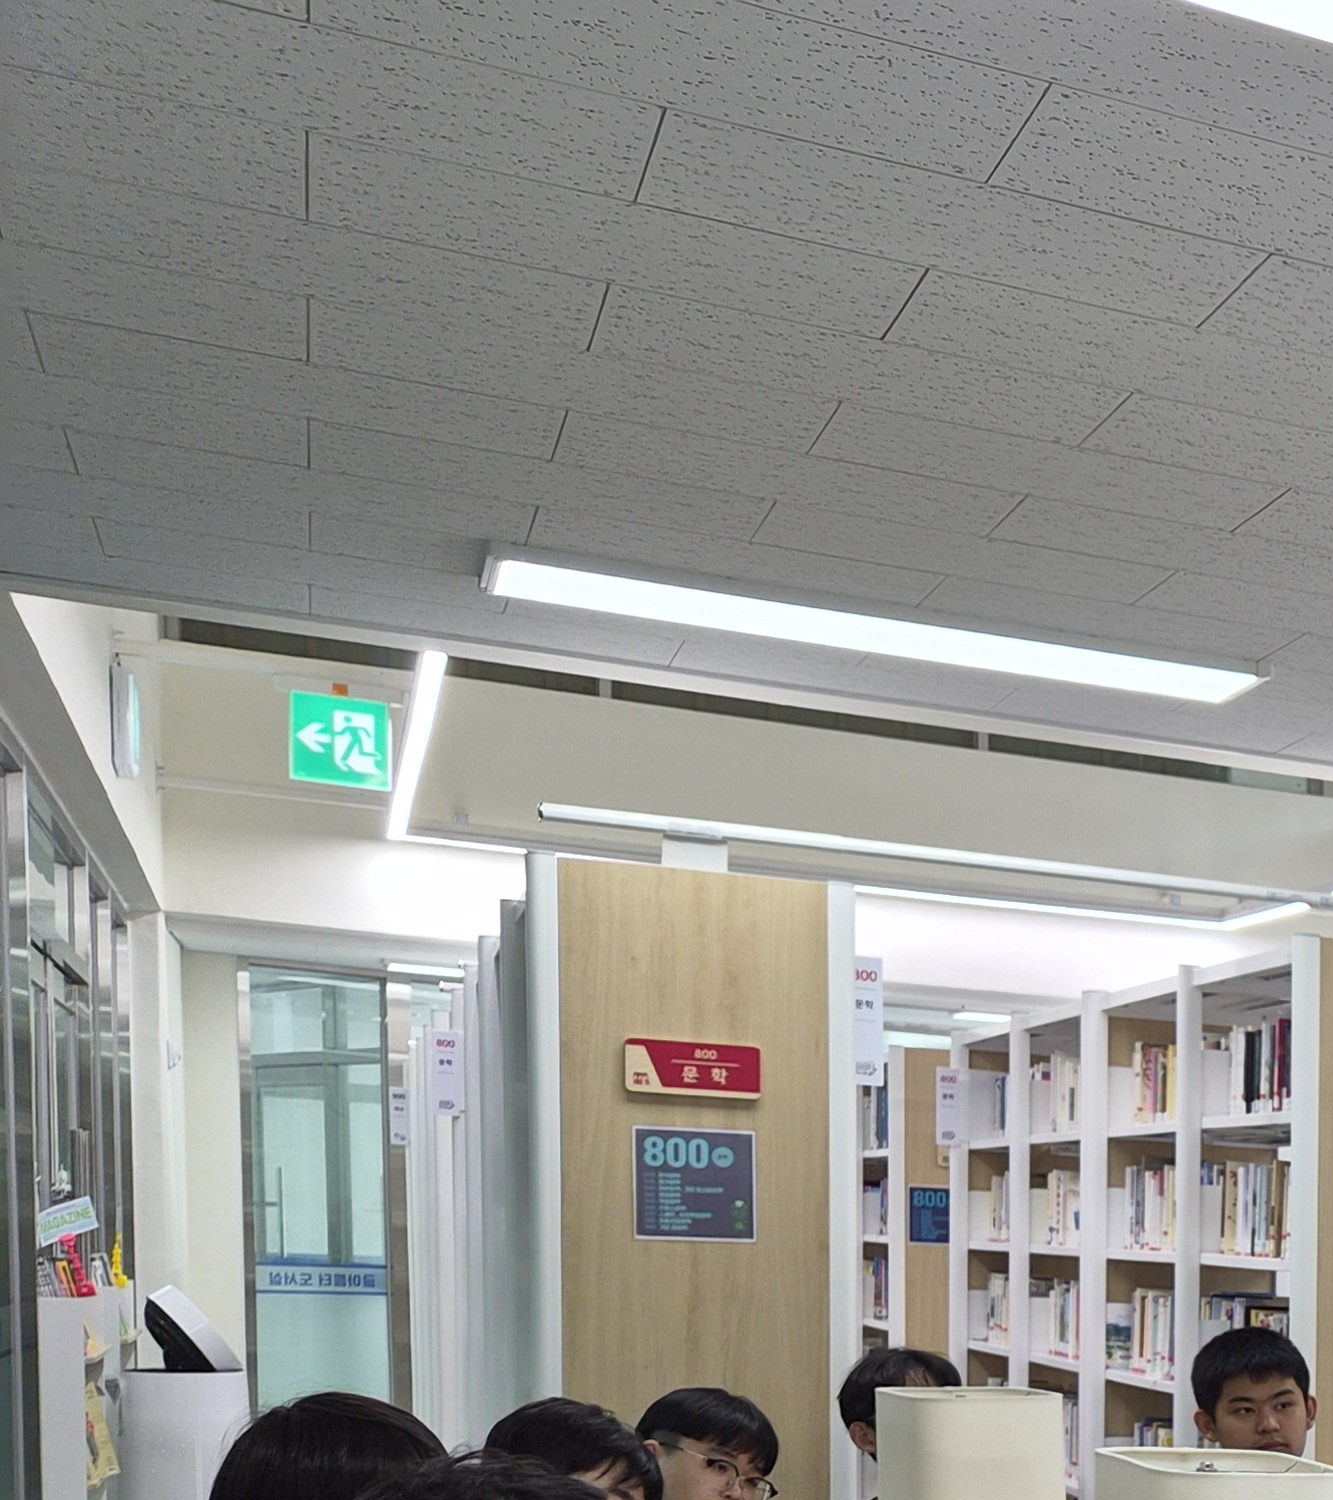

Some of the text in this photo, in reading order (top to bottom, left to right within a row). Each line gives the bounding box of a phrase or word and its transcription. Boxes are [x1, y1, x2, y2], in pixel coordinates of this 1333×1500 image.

[694, 1049, 718, 1060] 800
[643, 1136, 710, 1169] 800
[913, 1191, 947, 1208] 800
